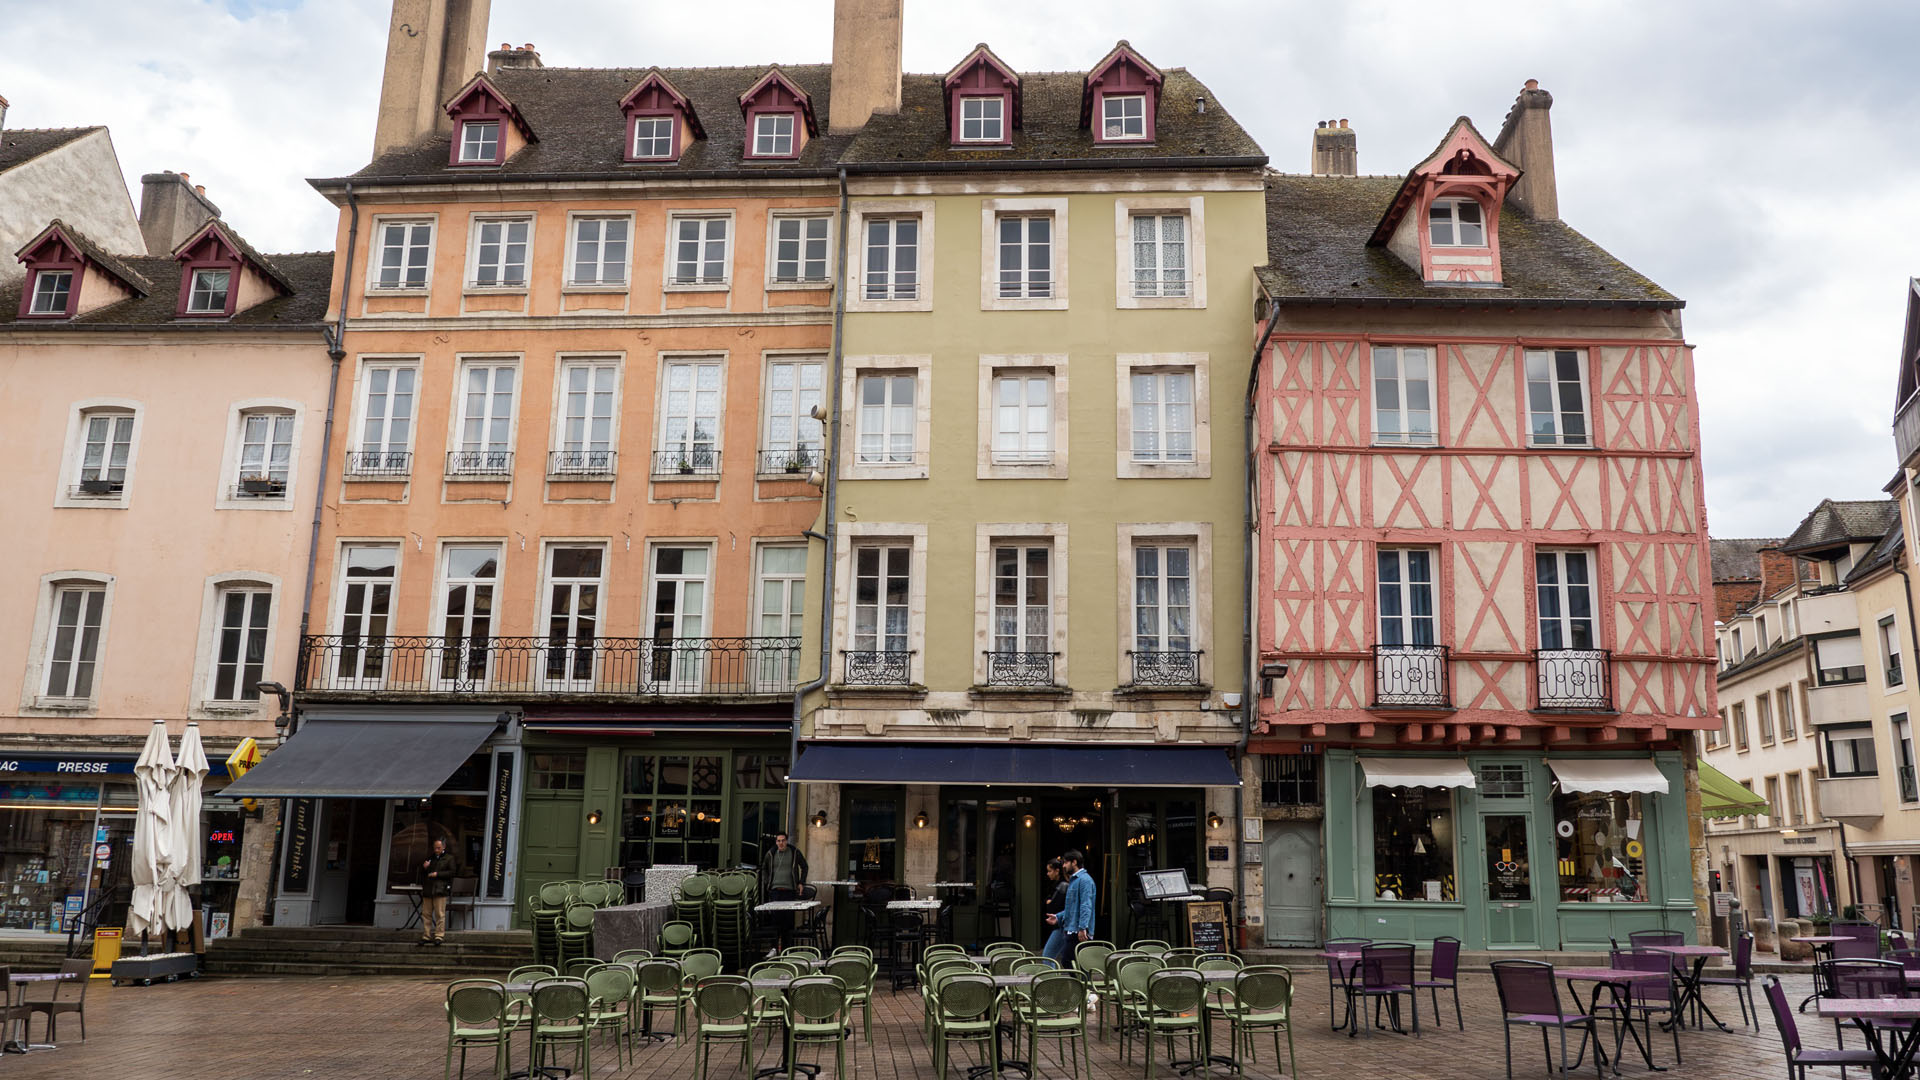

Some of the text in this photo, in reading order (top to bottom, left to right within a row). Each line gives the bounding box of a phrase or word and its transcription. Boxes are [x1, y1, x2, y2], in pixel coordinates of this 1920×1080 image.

[1303, 745, 1312, 753] 11
[0, 761, 109, 773] AC PRESSE
[297, 805, 307, 832] and
[211, 832, 233, 841] OPEN
[291, 834, 305, 879] Drinks
[494, 850, 504, 881] Salade
